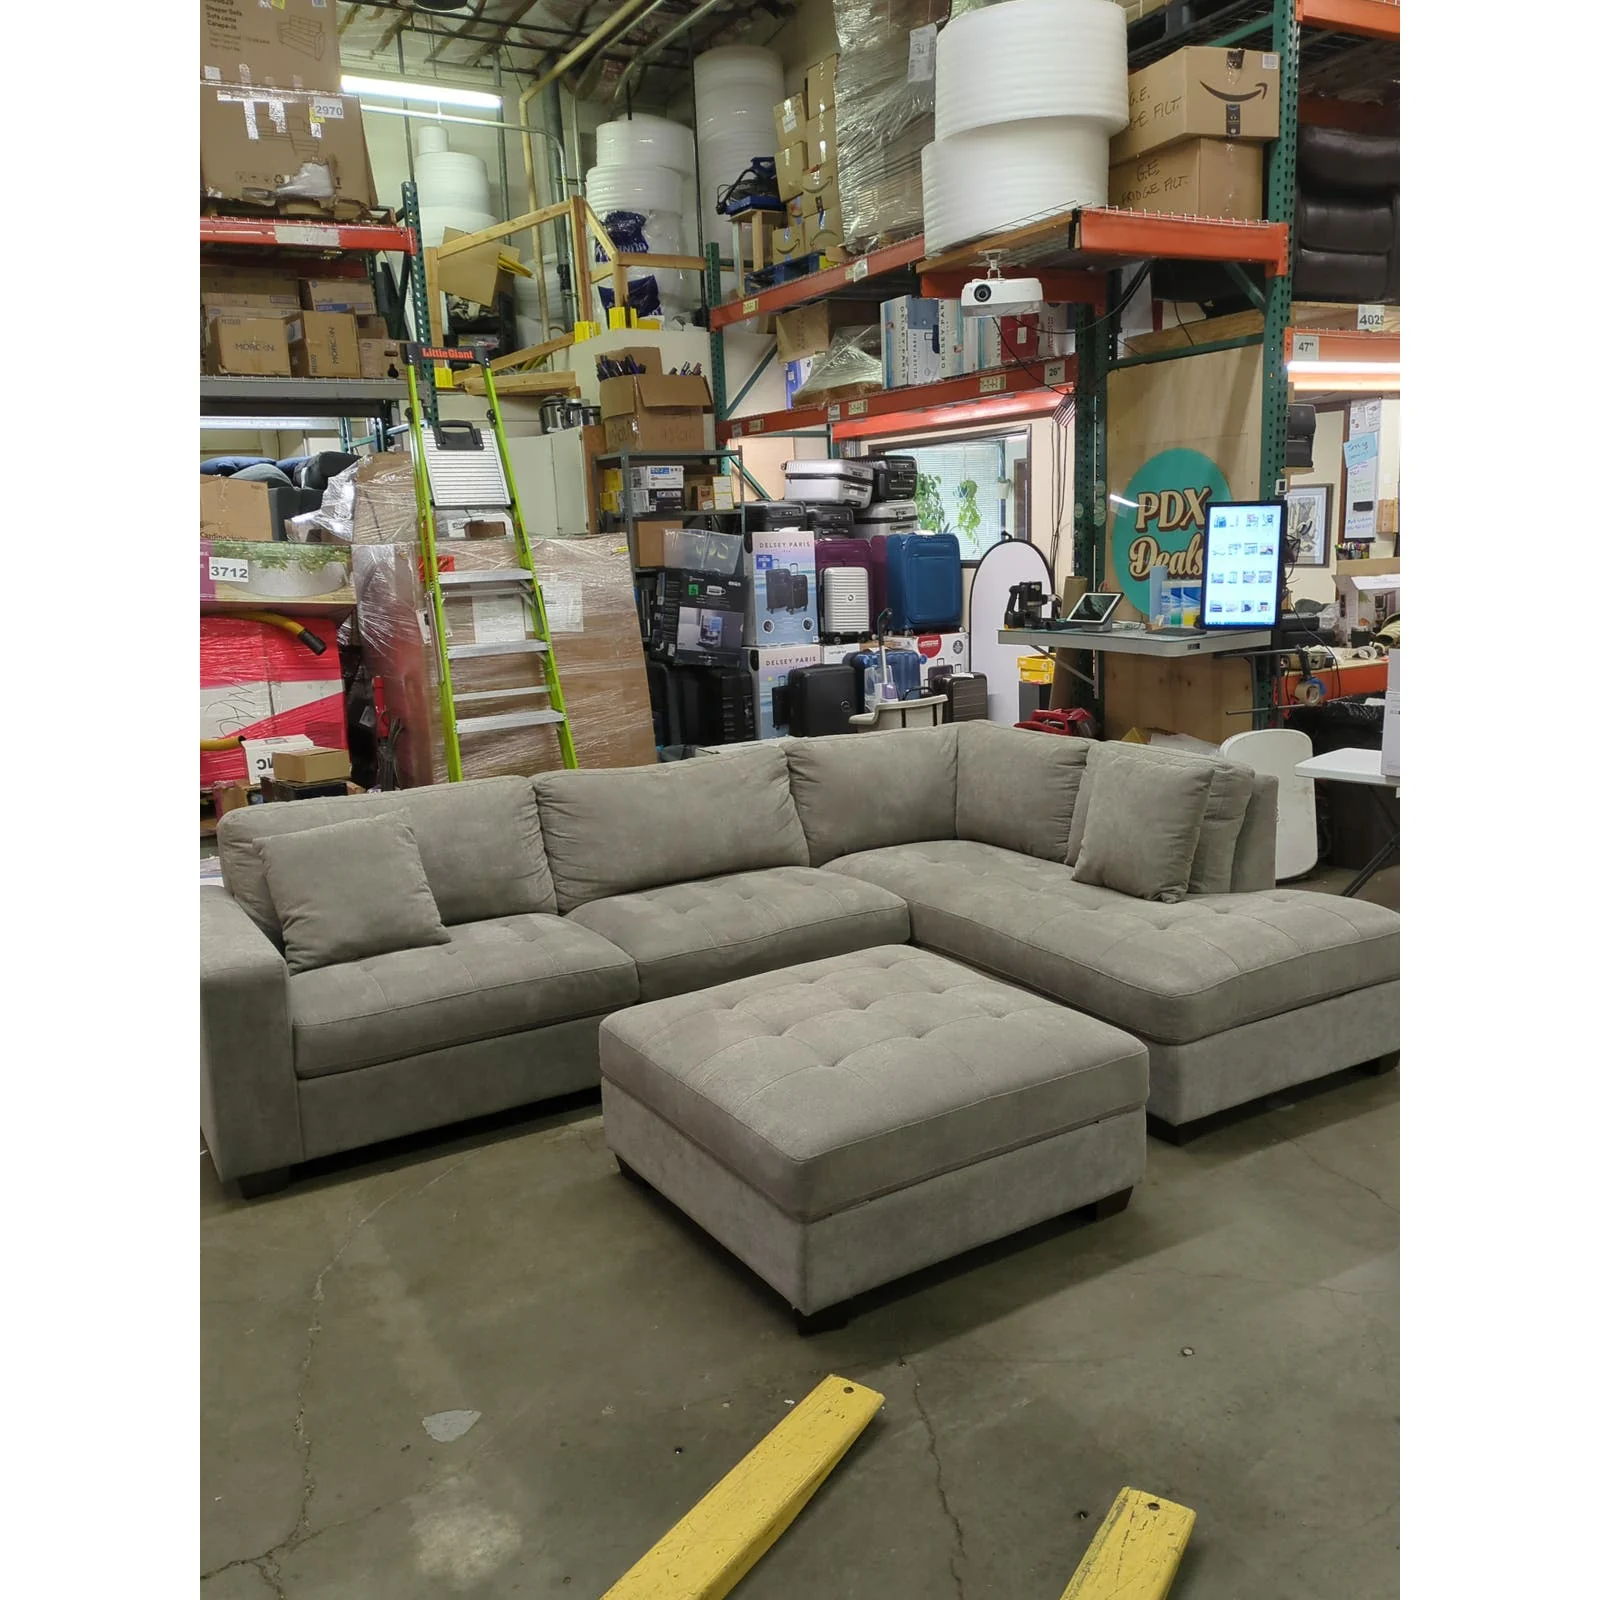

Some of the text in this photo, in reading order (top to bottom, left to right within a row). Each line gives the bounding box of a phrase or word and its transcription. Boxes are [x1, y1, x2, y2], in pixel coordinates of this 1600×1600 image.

[316, 105, 343, 116] 2970
[1135, 486, 1212, 532] PDX
[1129, 532, 1204, 581] Deals
[211, 566, 248, 578] 3712
